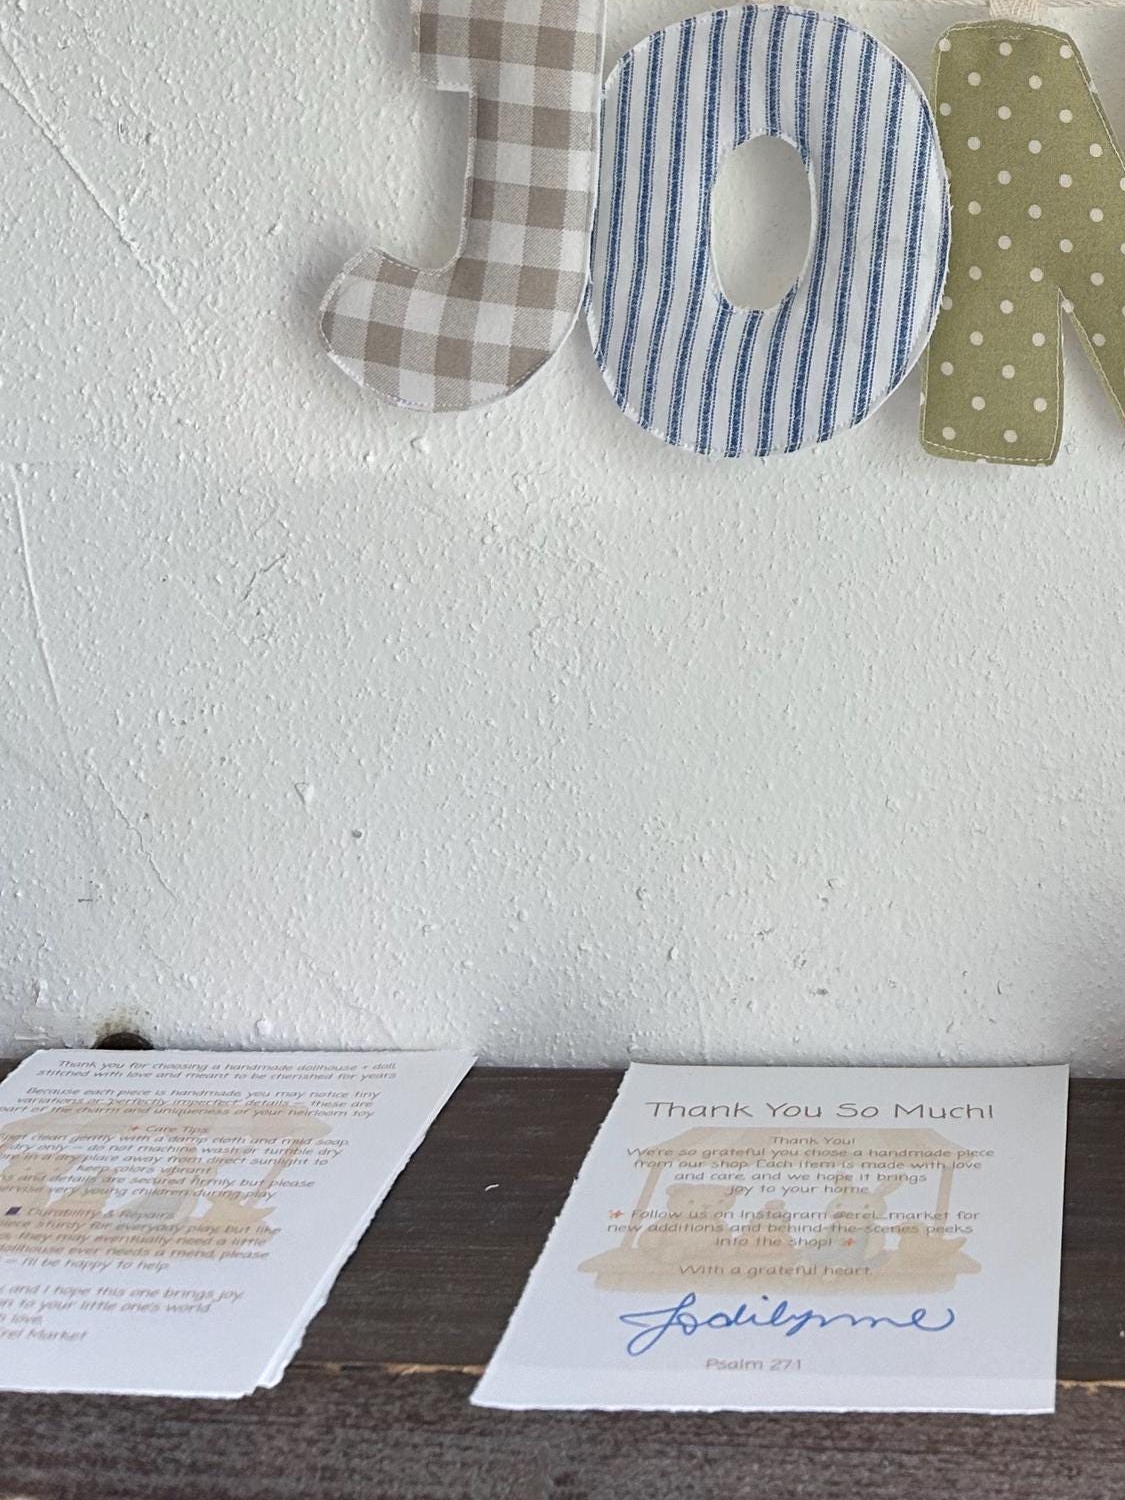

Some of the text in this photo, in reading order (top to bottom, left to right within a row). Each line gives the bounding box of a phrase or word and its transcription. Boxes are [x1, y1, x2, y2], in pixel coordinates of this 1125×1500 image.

[646, 1102, 993, 1119] Thank You So Much!
[772, 1136, 855, 1145] Thank You!
[702, 1148, 764, 1159] grateful
[772, 1149, 798, 1159] you
[804, 1149, 847, 1157] chose
[957, 1150, 995, 1159] piece
[634, 1160, 672, 1168] from
[756, 1160, 792, 1168] Each
[862, 1161, 905, 1169] made
[911, 1161, 946, 1169] with
[953, 1161, 982, 1169] love
[675, 1172, 704, 1180] and
[752, 1172, 780, 1180] and
[817, 1173, 853, 1183] hope
[860, 1173, 870, 1181] it
[877, 1173, 927, 1184] brings
[724, 1185, 753, 1196] joy
[760, 1185, 775, 1193] to
[782, 1186, 820, 1196] your
[631, 1210, 683, 1218] Follow
[689, 1211, 708, 1219] us
[714, 1211, 733, 1219] on
[741, 1210, 827, 1221] Instagram
[957, 1211, 980, 1220] for
[608, 1224, 642, 1232] new
[648, 1223, 723, 1232] additions
[730, 1224, 761, 1232] and
[927, 1225, 973, 1236] peeks
[716, 1237, 748, 1246] into
[755, 1237, 782, 1246] the
[680, 1266, 724, 1275] With
[747, 1265, 817, 1278] grateful
[164, 1288, 214, 1301] brings
[706, 1358, 763, 1369] Psalm
